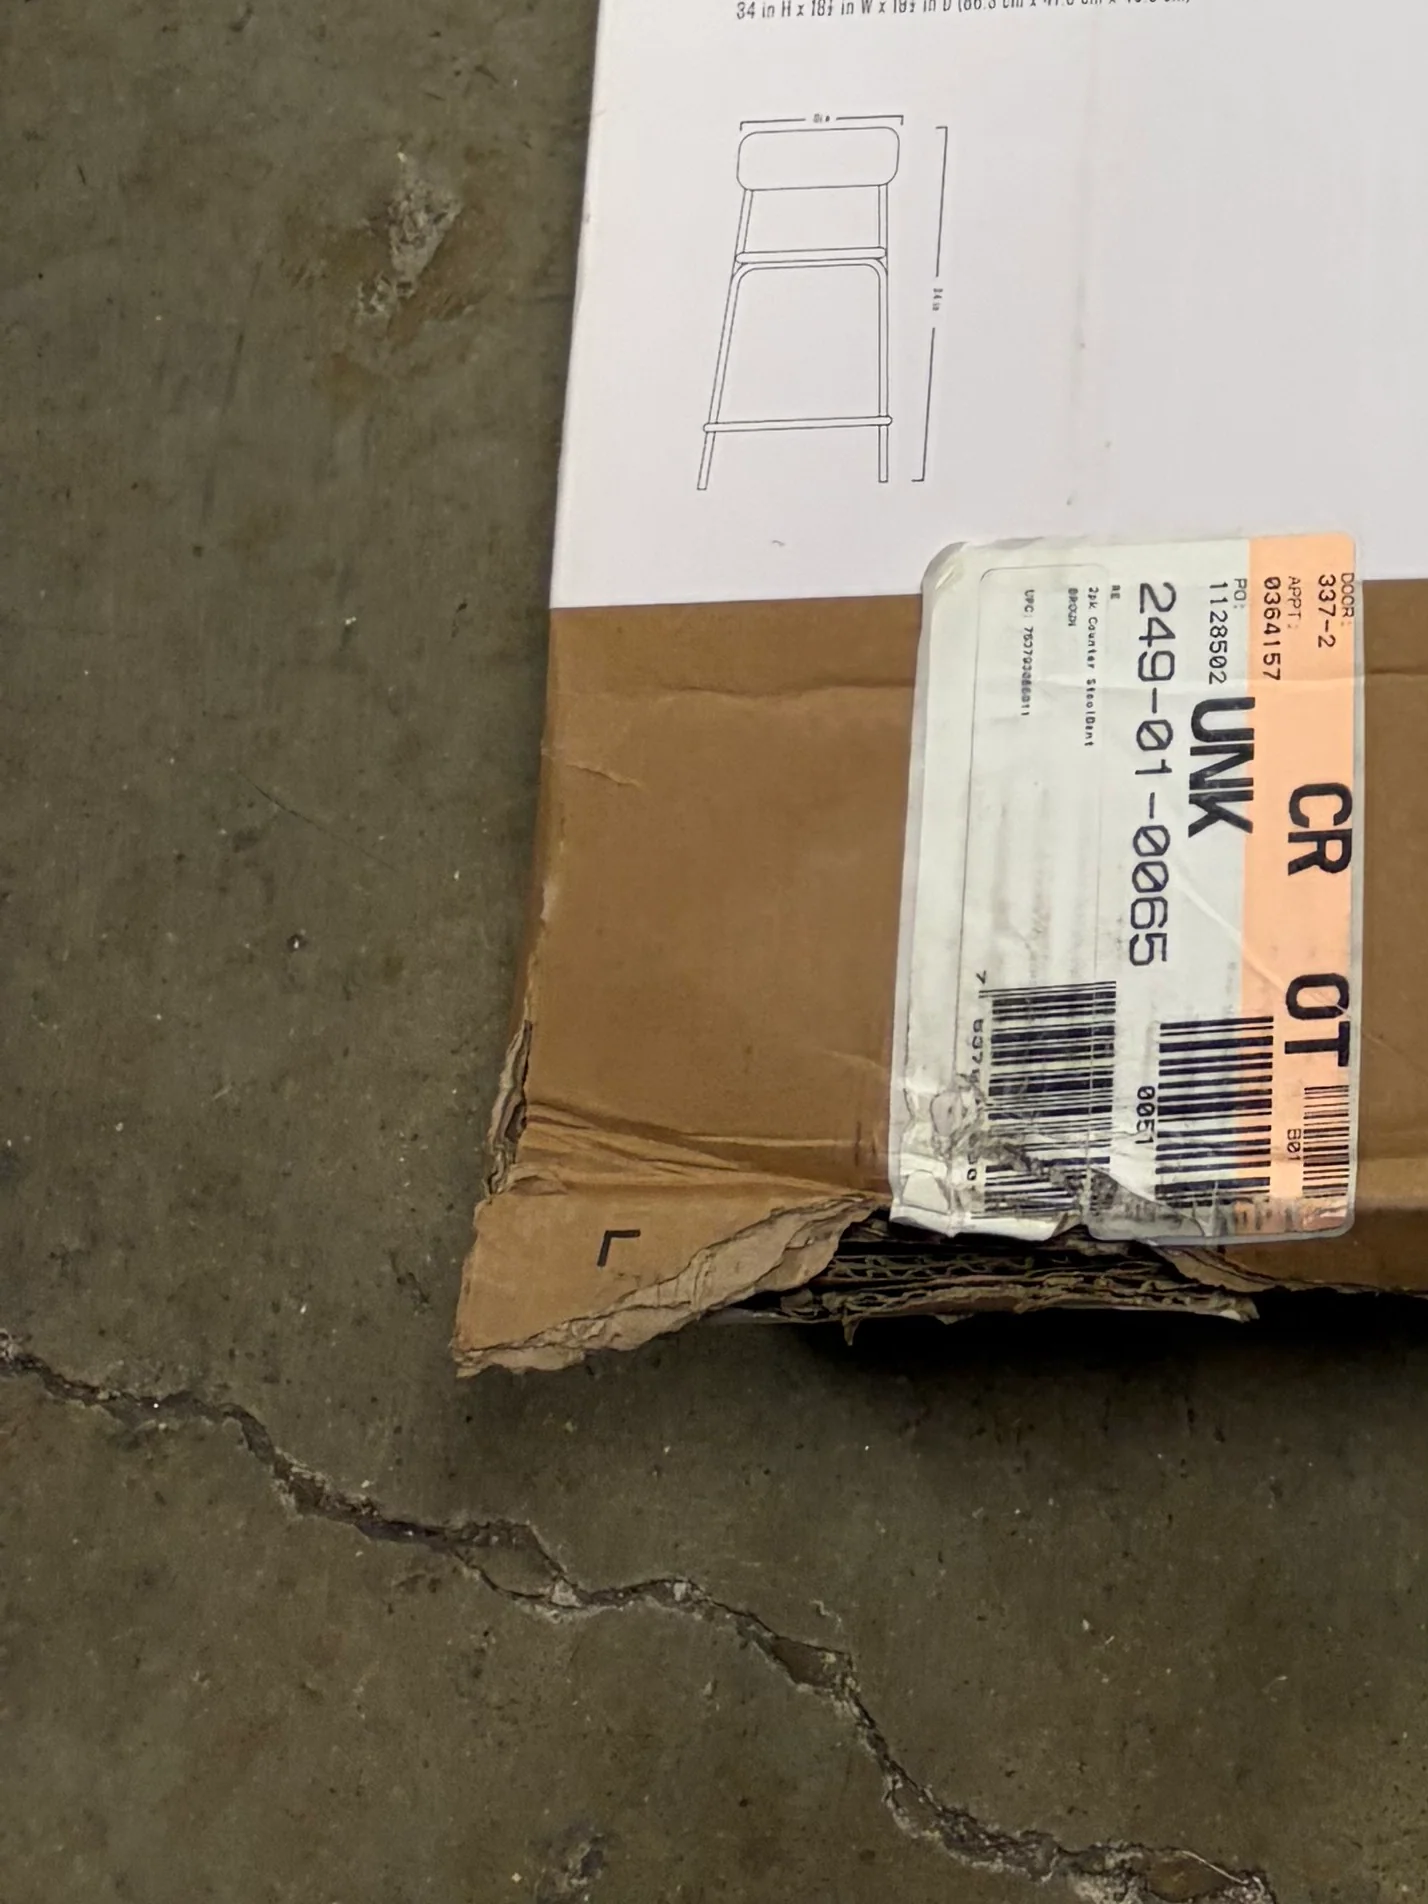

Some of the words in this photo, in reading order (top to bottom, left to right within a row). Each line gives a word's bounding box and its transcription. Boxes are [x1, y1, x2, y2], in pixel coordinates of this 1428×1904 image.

[736, 1, 756, 20] 34
[762, 2, 775, 19] in
[781, 0, 791, 17] H
[796, 4, 804, 16] x
[841, 0, 854, 16] in
[878, 2, 886, 14] x
[1233, 578, 1248, 609] PO:
[1263, 576, 1281, 681] 0364157
[1288, 575, 1302, 629] APPT:
[1318, 574, 1336, 649] 337-2
[1087, 616, 1098, 669] Counter
[1208, 581, 1228, 685] 1128502
[1128, 580, 1176, 969] 249-01-0065
[1188, 696, 1256, 839] UNK
[1287, 782, 1353, 876] CR
[1137, 1085, 1156, 1146] 0051
